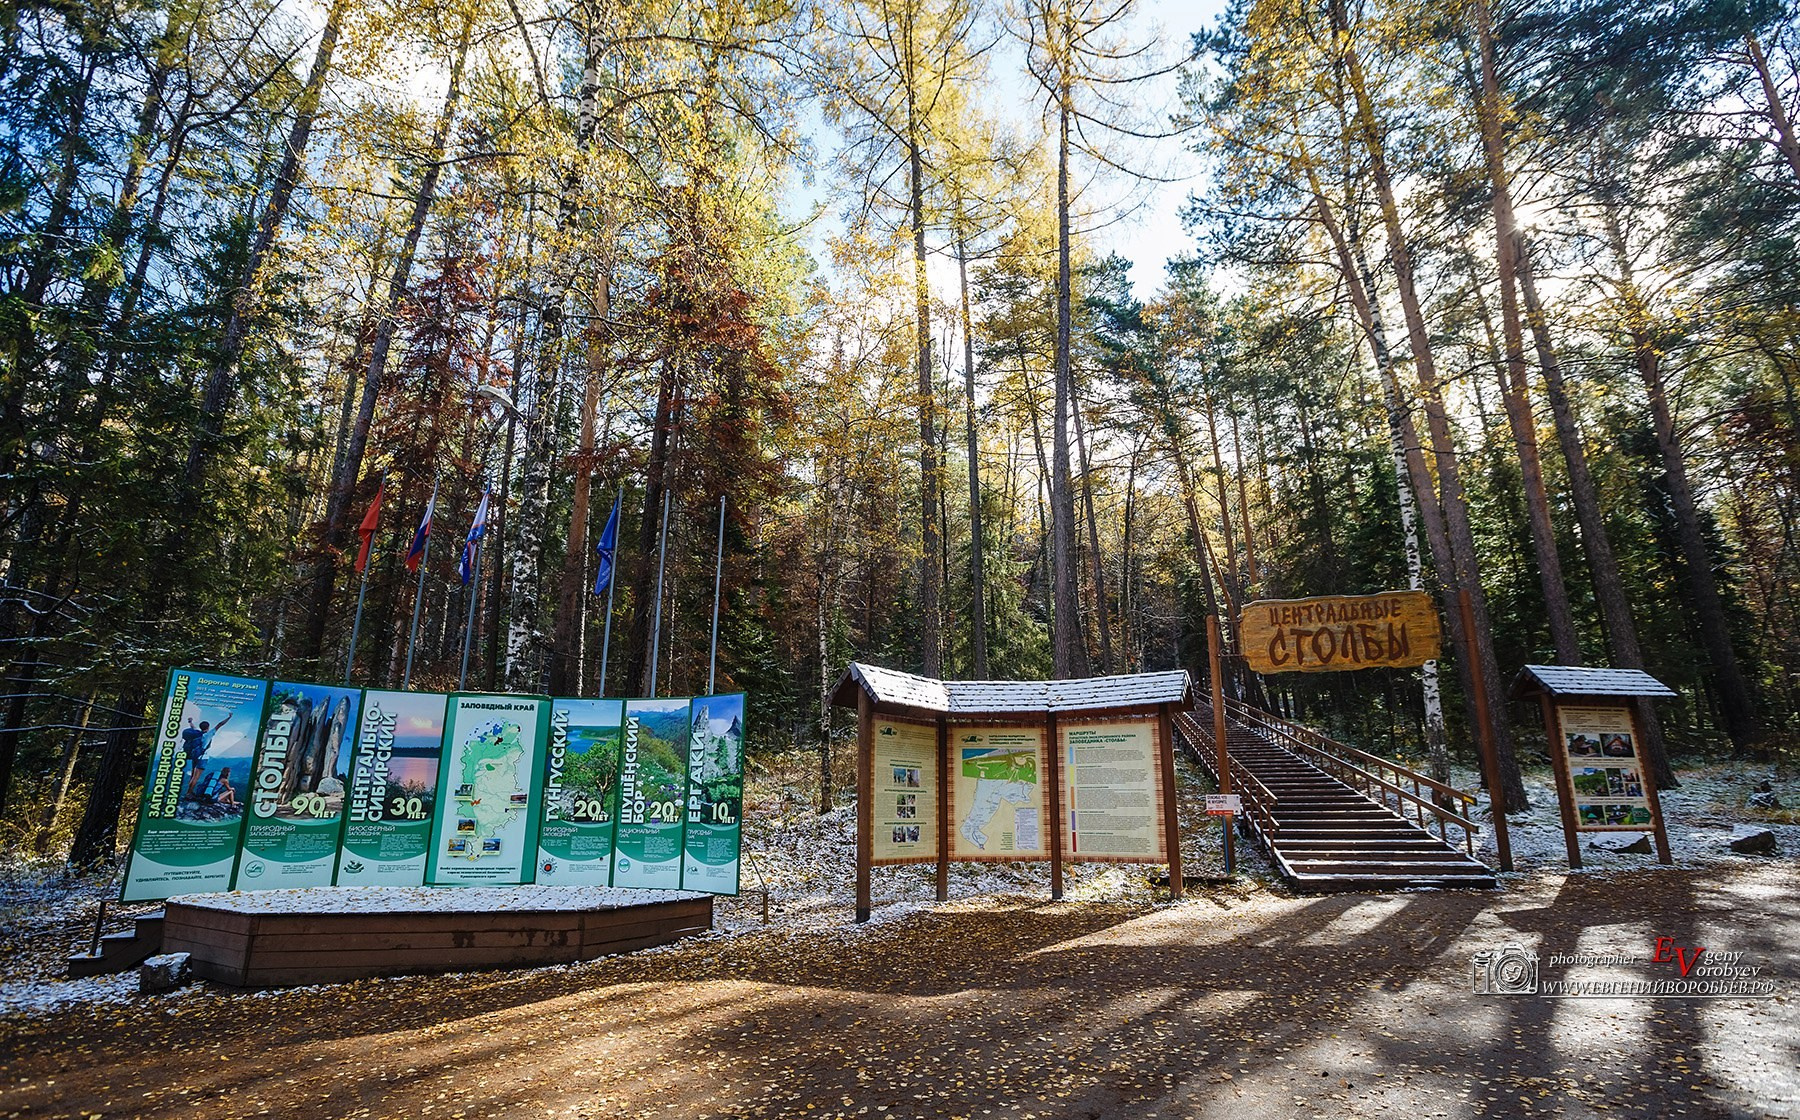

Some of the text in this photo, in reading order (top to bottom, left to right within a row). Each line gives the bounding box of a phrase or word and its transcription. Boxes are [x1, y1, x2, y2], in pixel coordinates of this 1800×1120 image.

[1269, 622, 1409, 667] СТОЛБЫ
[198, 677, 230, 688] Дорогие
[461, 702, 513, 711] ЗАПОВЕДНЫЙ
[149, 675, 189, 818] ЗАПОВЕДНОЕ СОЗВЕЗДИЕ
[254, 712, 293, 818] СТОЛБЫ
[350, 701, 383, 822] ЦЕНТРАЛЬНО-
[367, 711, 397, 822] СИБИРСКИЙ
[545, 709, 570, 822] ТУНГУССКИЙ
[164, 751, 187, 818] ЮБИЛЯРОВ
[688, 729, 705, 823] ЕРГАКИ
[291, 796, 326, 816] 90
[390, 797, 423, 816] 30
[573, 800, 601, 818] 20
[633, 790, 646, 824] БОР
[650, 801, 675, 819] 20
[663, 815, 679, 823] ЛЕТ
[711, 802, 729, 820] 10
[721, 816, 735, 824] ЛЕТ
[249, 824, 296, 832] ПРИРОДНЫЙ
[348, 824, 396, 832] БИОСФЕРНЫЙ
